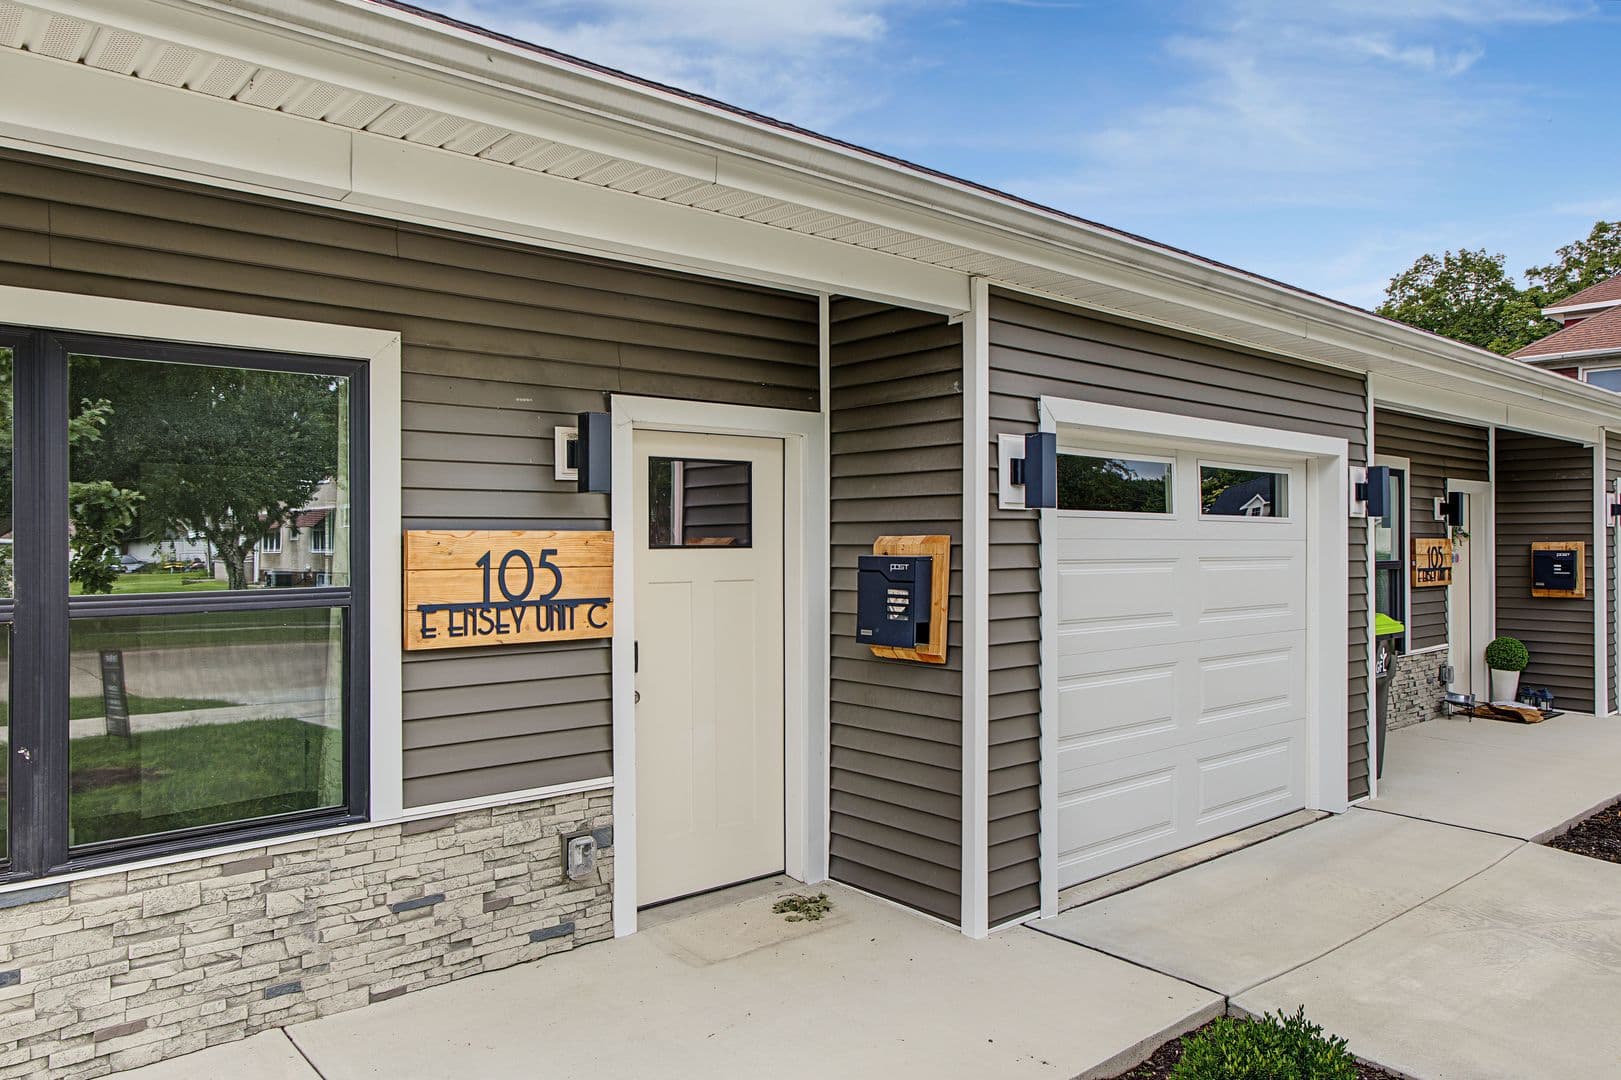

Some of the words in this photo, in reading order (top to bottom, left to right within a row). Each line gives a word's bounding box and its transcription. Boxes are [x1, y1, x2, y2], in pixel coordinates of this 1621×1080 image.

[475, 548, 563, 603] 105
[1427, 545, 1443, 569] 105
[420, 604, 437, 639] E
[448, 602, 526, 637] ENSEY
[536, 602, 577, 632] UNIT
[587, 602, 609, 629] C
